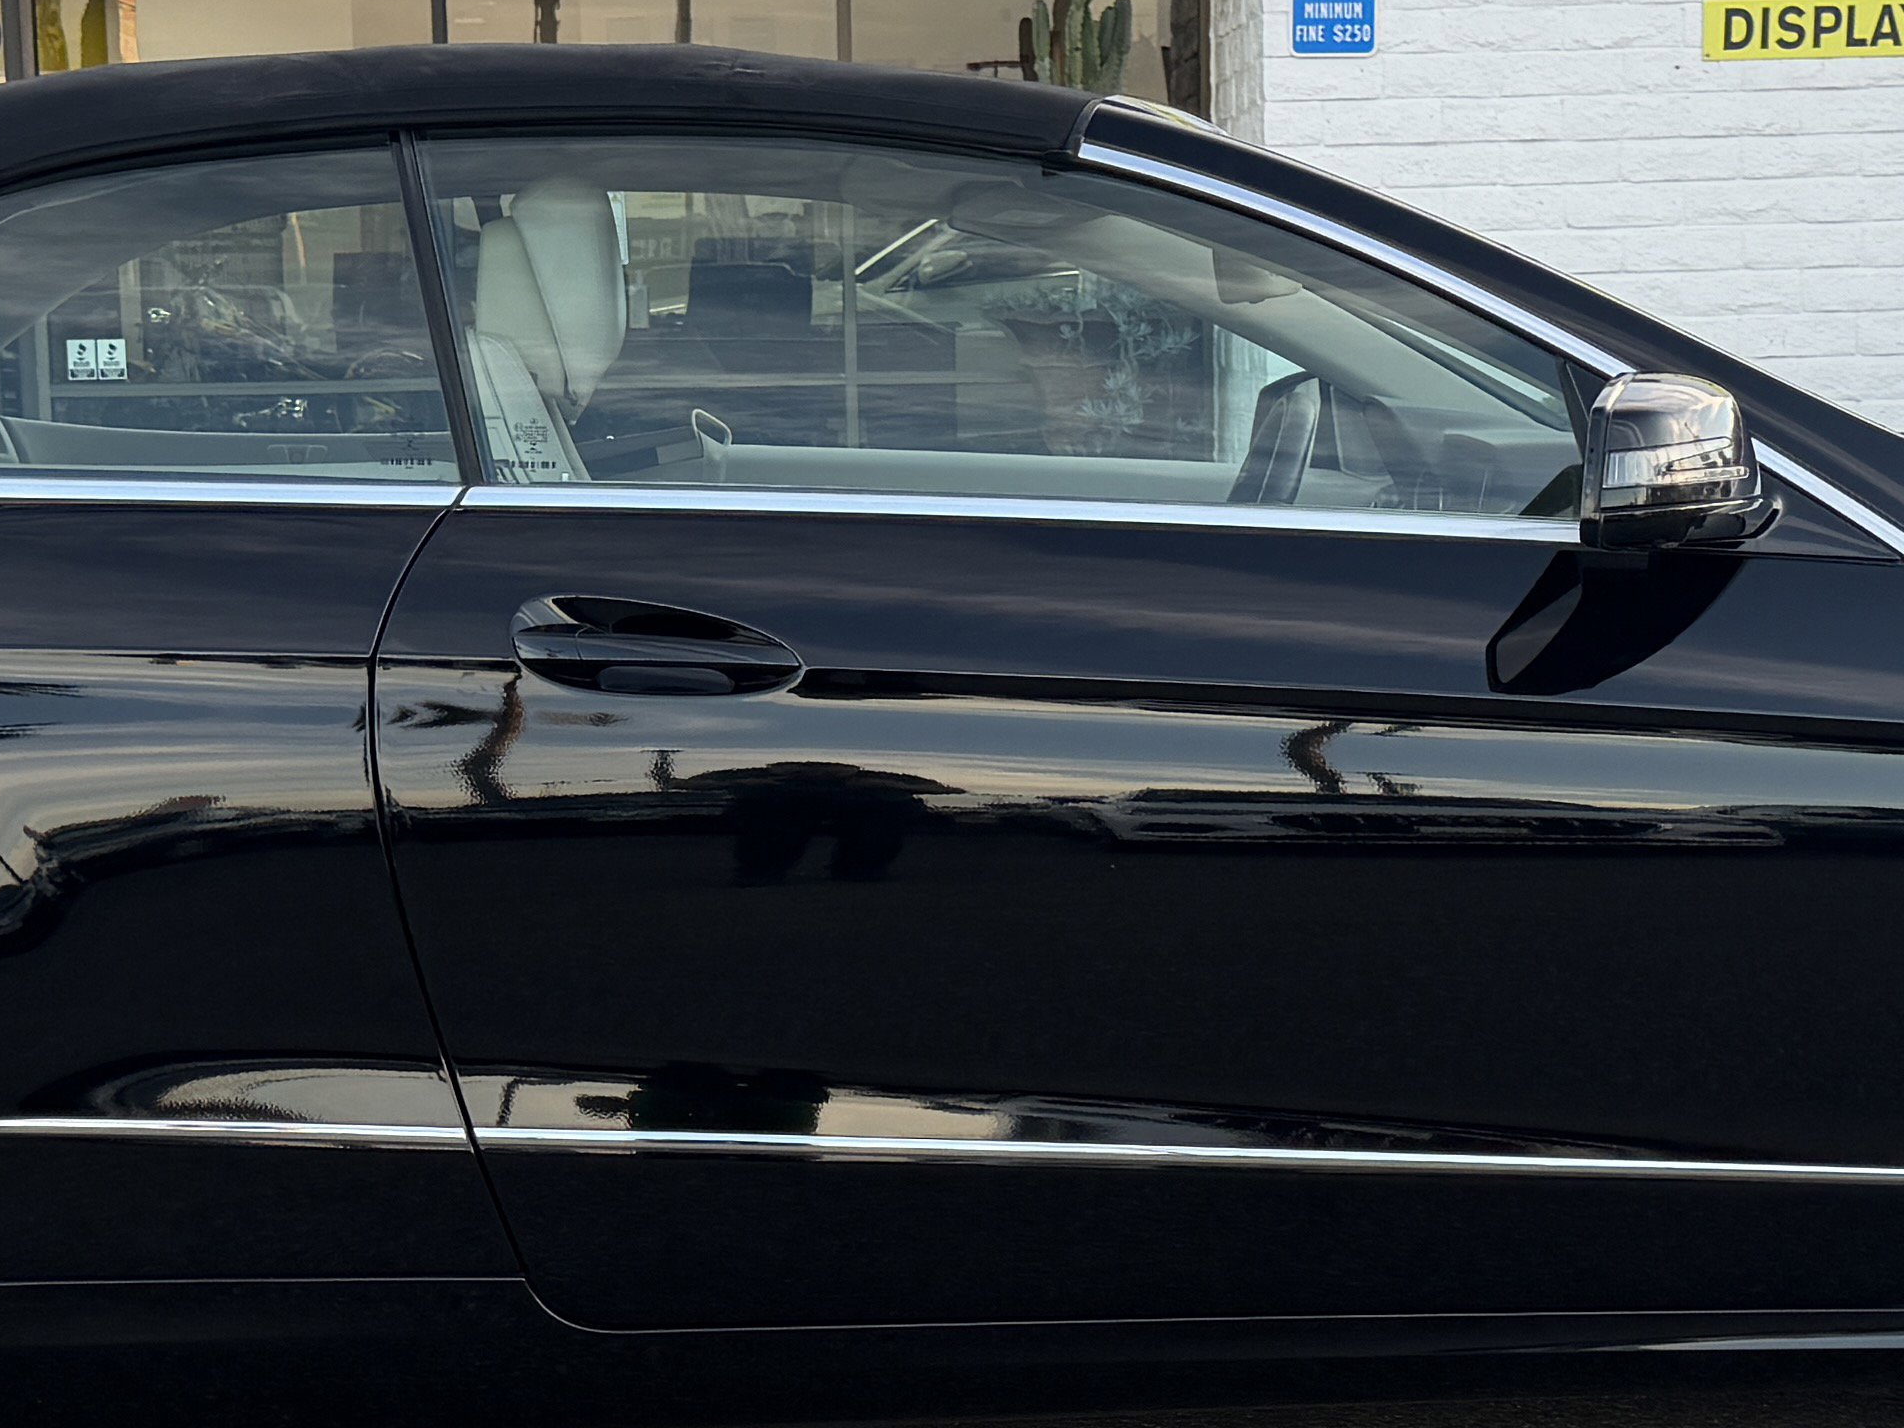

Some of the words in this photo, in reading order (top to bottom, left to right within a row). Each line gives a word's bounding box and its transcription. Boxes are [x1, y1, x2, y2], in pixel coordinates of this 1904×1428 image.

[1303, 1, 1364, 20] MINIMUM
[1295, 24, 1326, 43] FINE
[1332, 23, 1372, 44] $250
